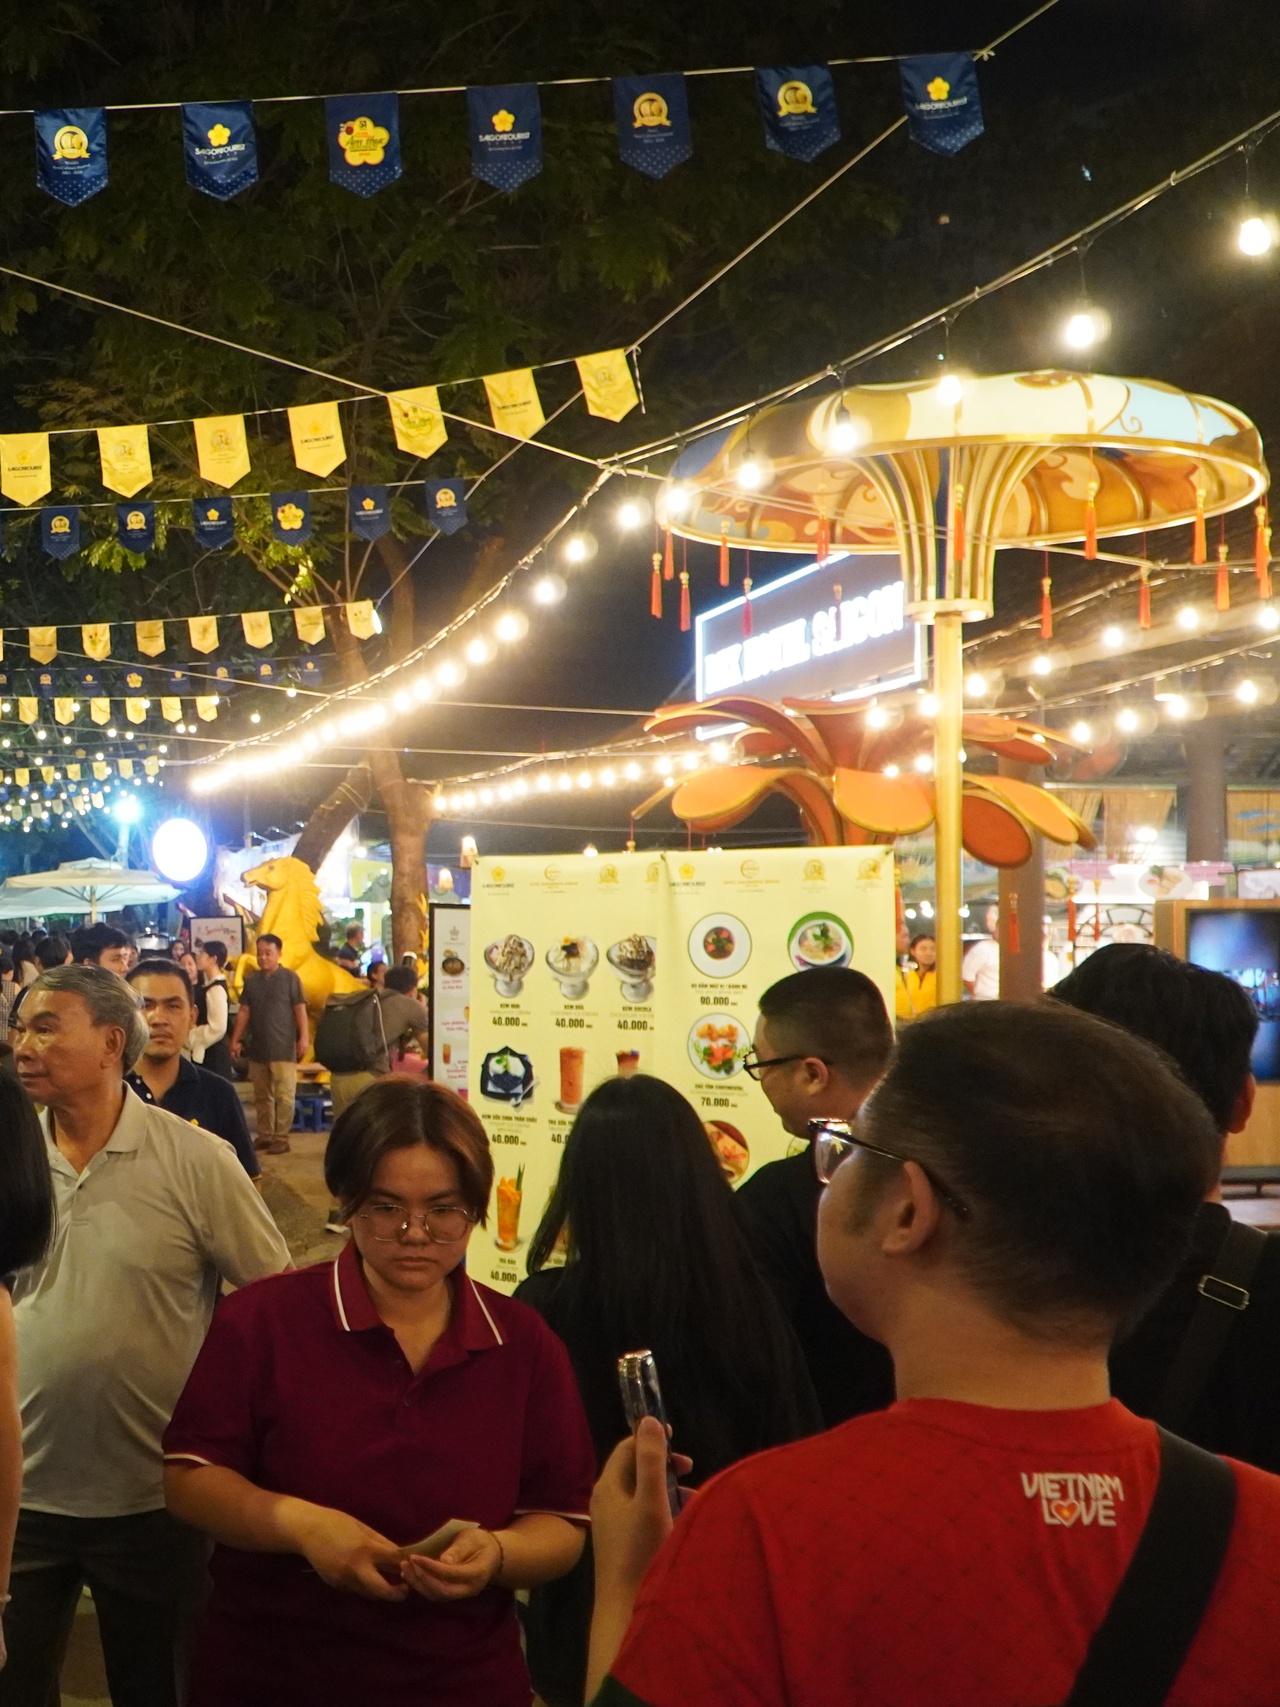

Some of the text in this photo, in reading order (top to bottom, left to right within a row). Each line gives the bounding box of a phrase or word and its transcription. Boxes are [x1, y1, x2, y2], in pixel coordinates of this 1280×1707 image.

[700, 996, 729, 1006] 90.000
[492, 1017, 520, 1026] 40.000
[555, 1018, 585, 1028] 40.000
[617, 1020, 648, 1030] 40.000
[701, 1097, 729, 1107] 70.000
[492, 1134, 519, 1145] 40.000
[490, 1270, 517, 1283] 40.000
[1021, 1472, 1125, 1501] VIETNAM
